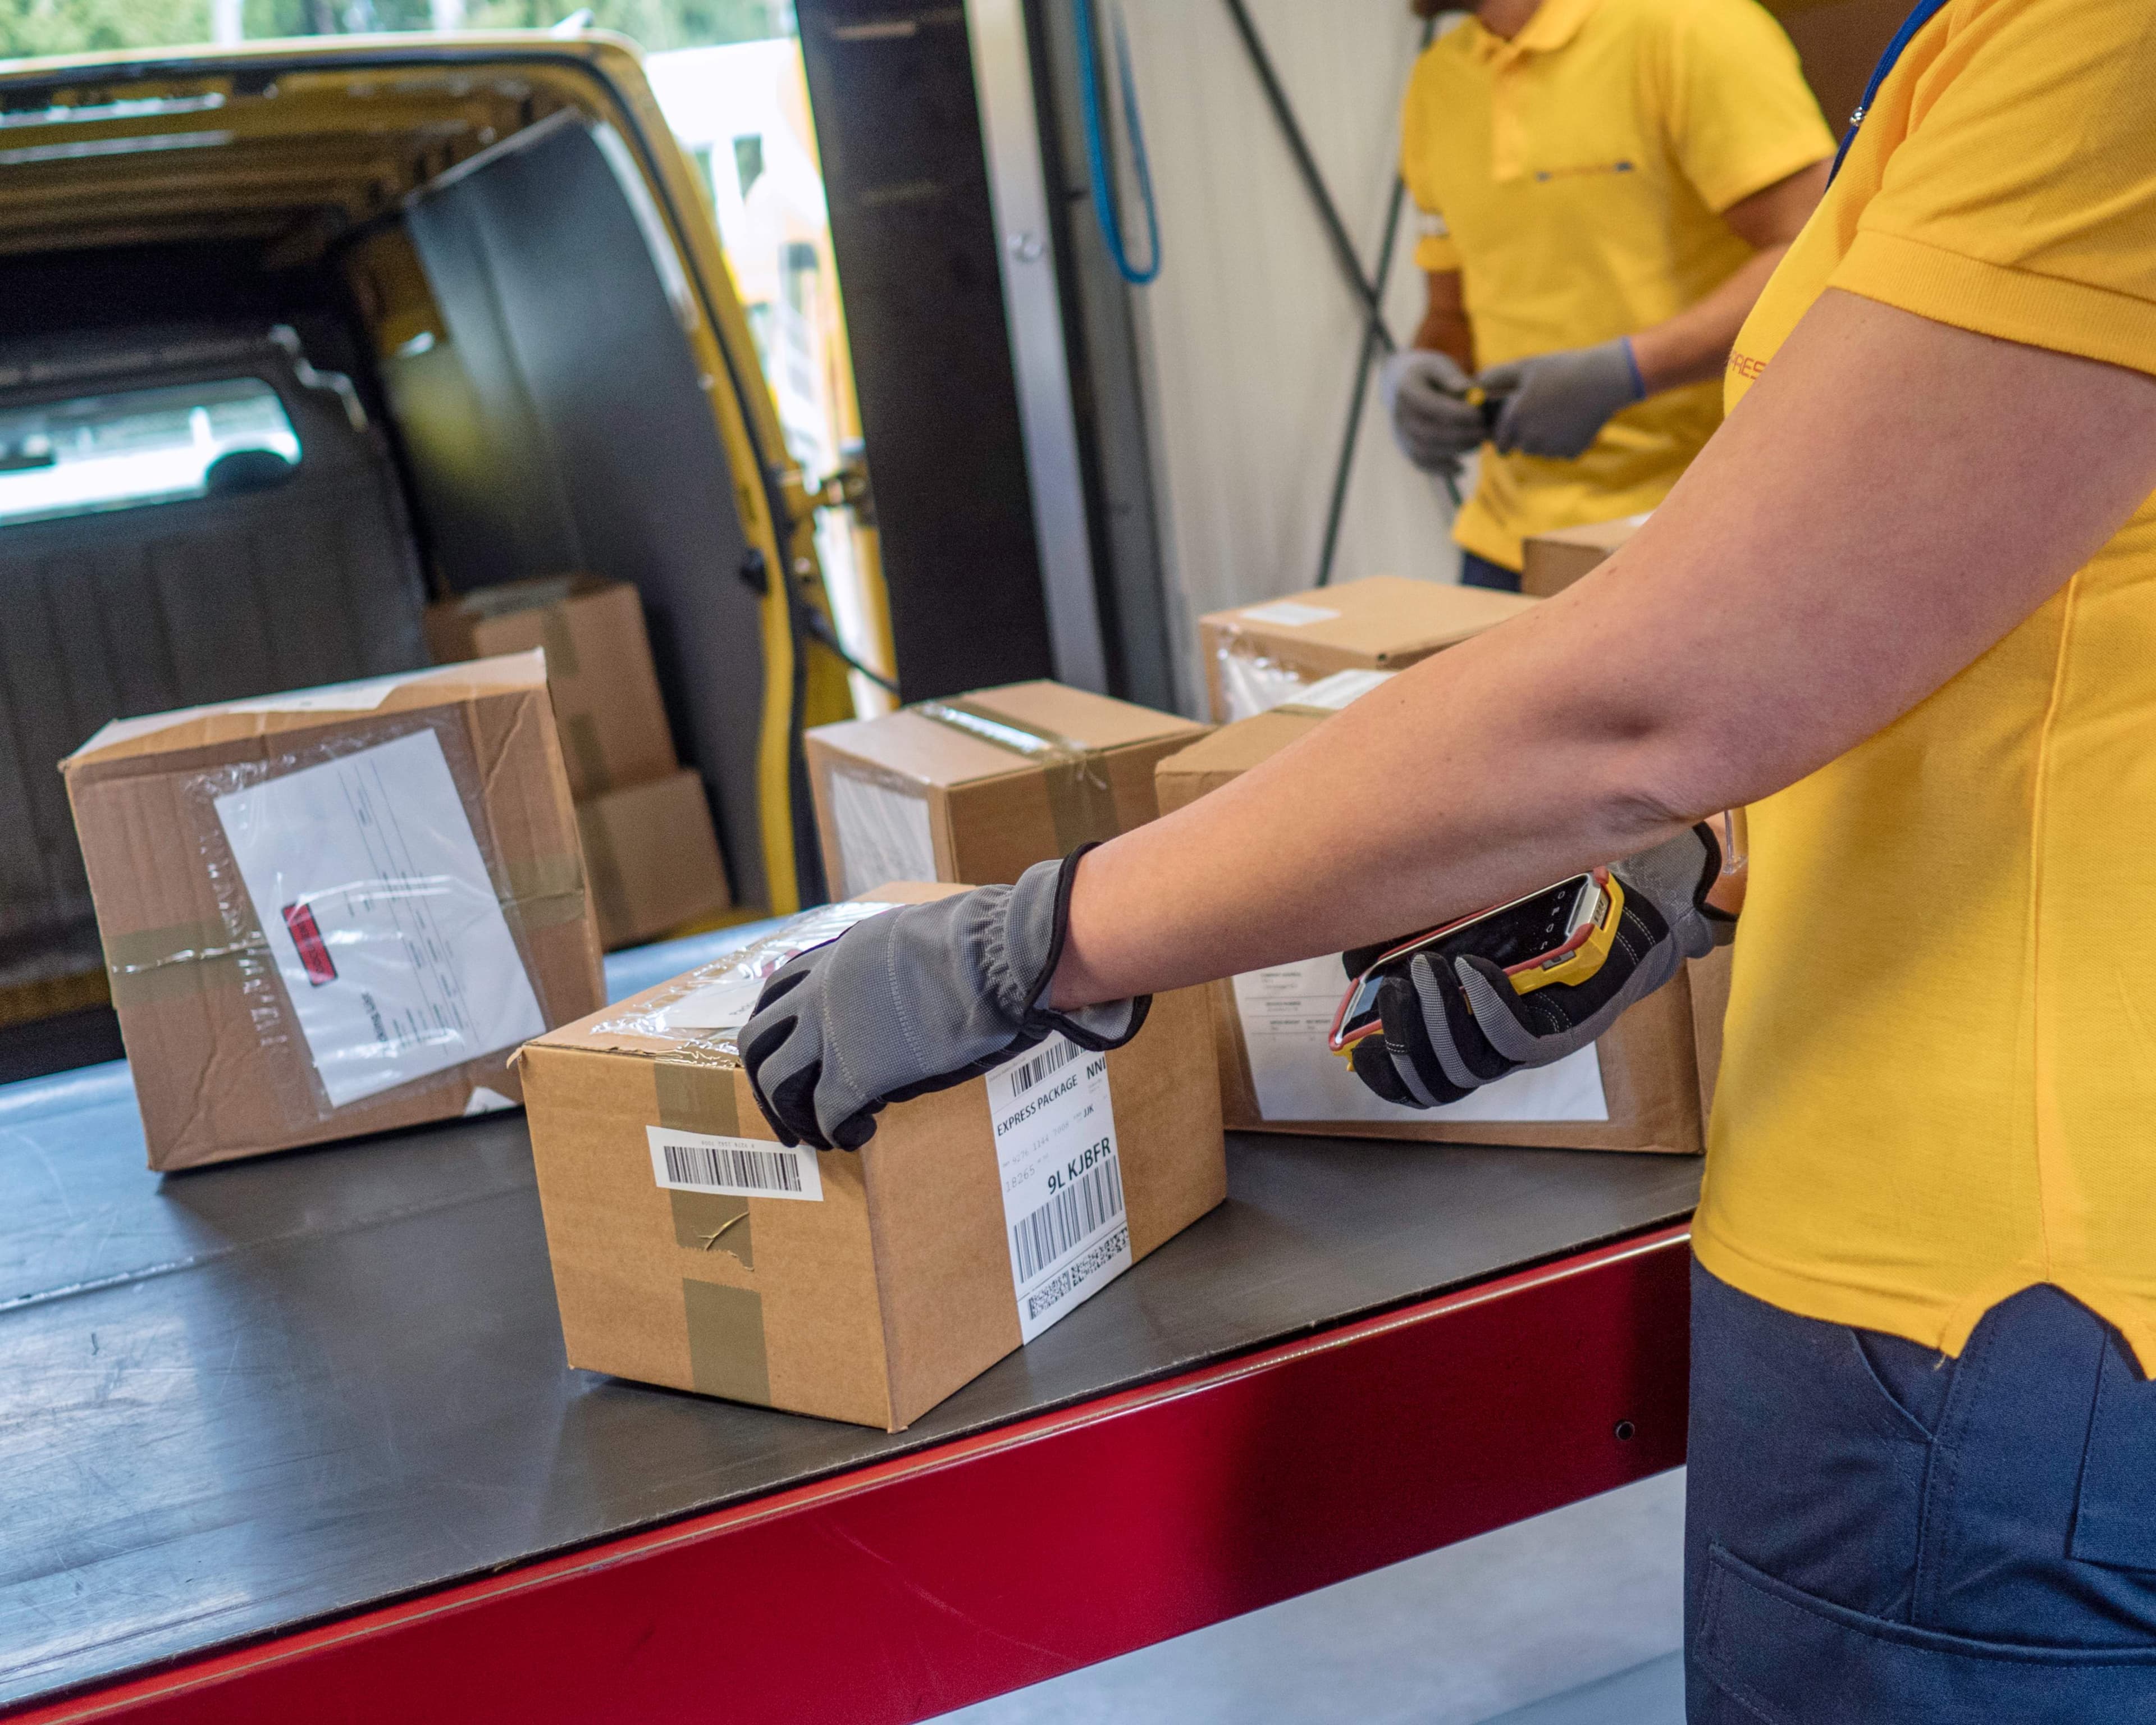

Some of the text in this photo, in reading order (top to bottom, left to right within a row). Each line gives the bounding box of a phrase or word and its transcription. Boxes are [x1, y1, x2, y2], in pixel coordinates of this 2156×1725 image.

[997, 1074, 1078, 1137] EXPRESS PACKAGE
[1006, 1164, 1035, 1193] 18265
[1047, 1137, 1112, 1195] 9L KJBFR
